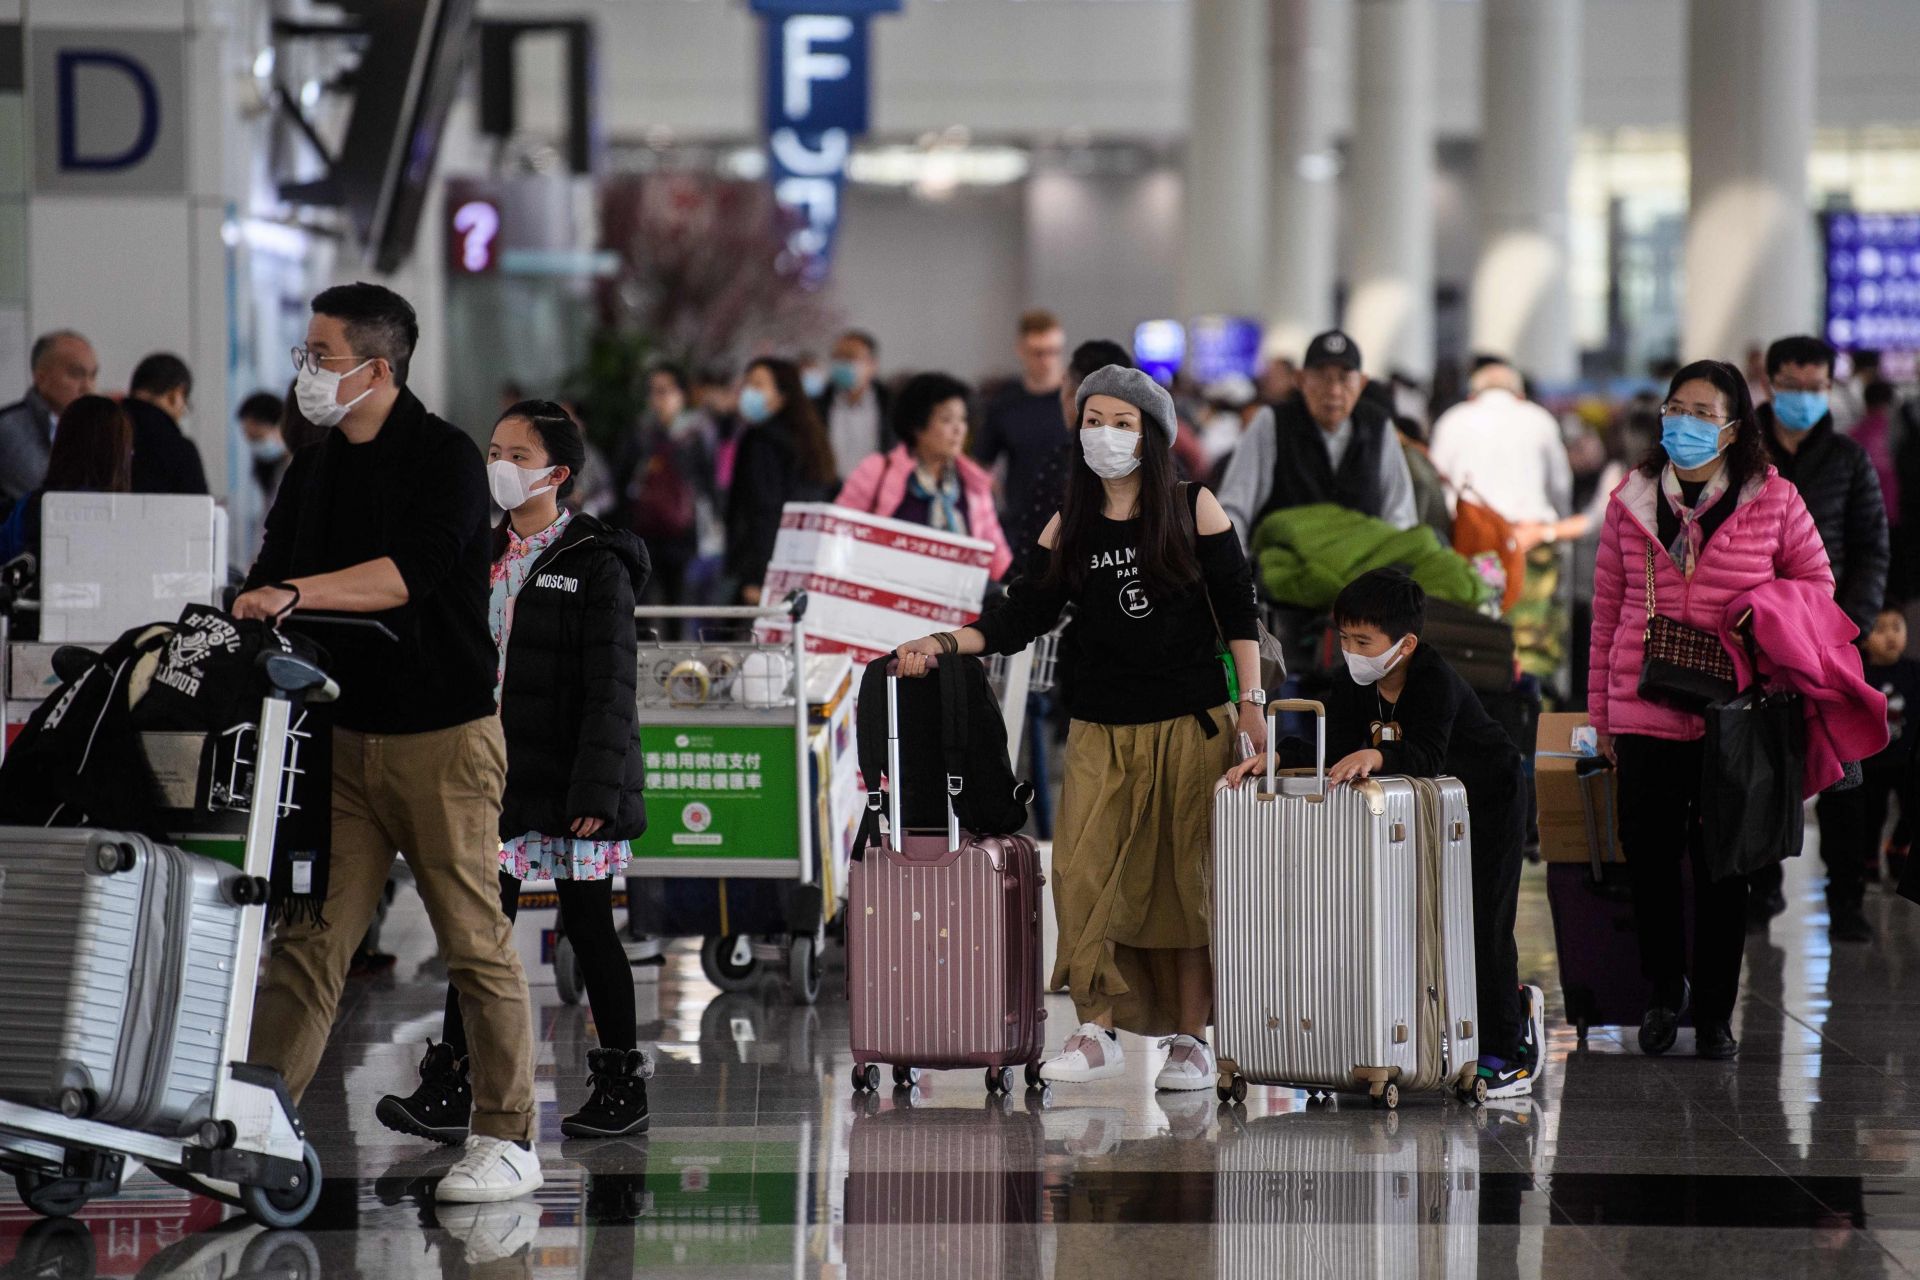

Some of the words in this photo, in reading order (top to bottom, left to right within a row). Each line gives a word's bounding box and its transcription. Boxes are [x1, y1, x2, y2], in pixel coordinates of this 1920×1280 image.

[783, 15, 853, 120] F
[57, 49, 161, 172] D
[1090, 547, 1136, 569] BALM
[536, 574, 578, 593] MOSCINO
[1117, 567, 1138, 578] PAR
[156, 664, 200, 697] LAMOUR
[642, 752, 761, 770] 香港用微信支付
